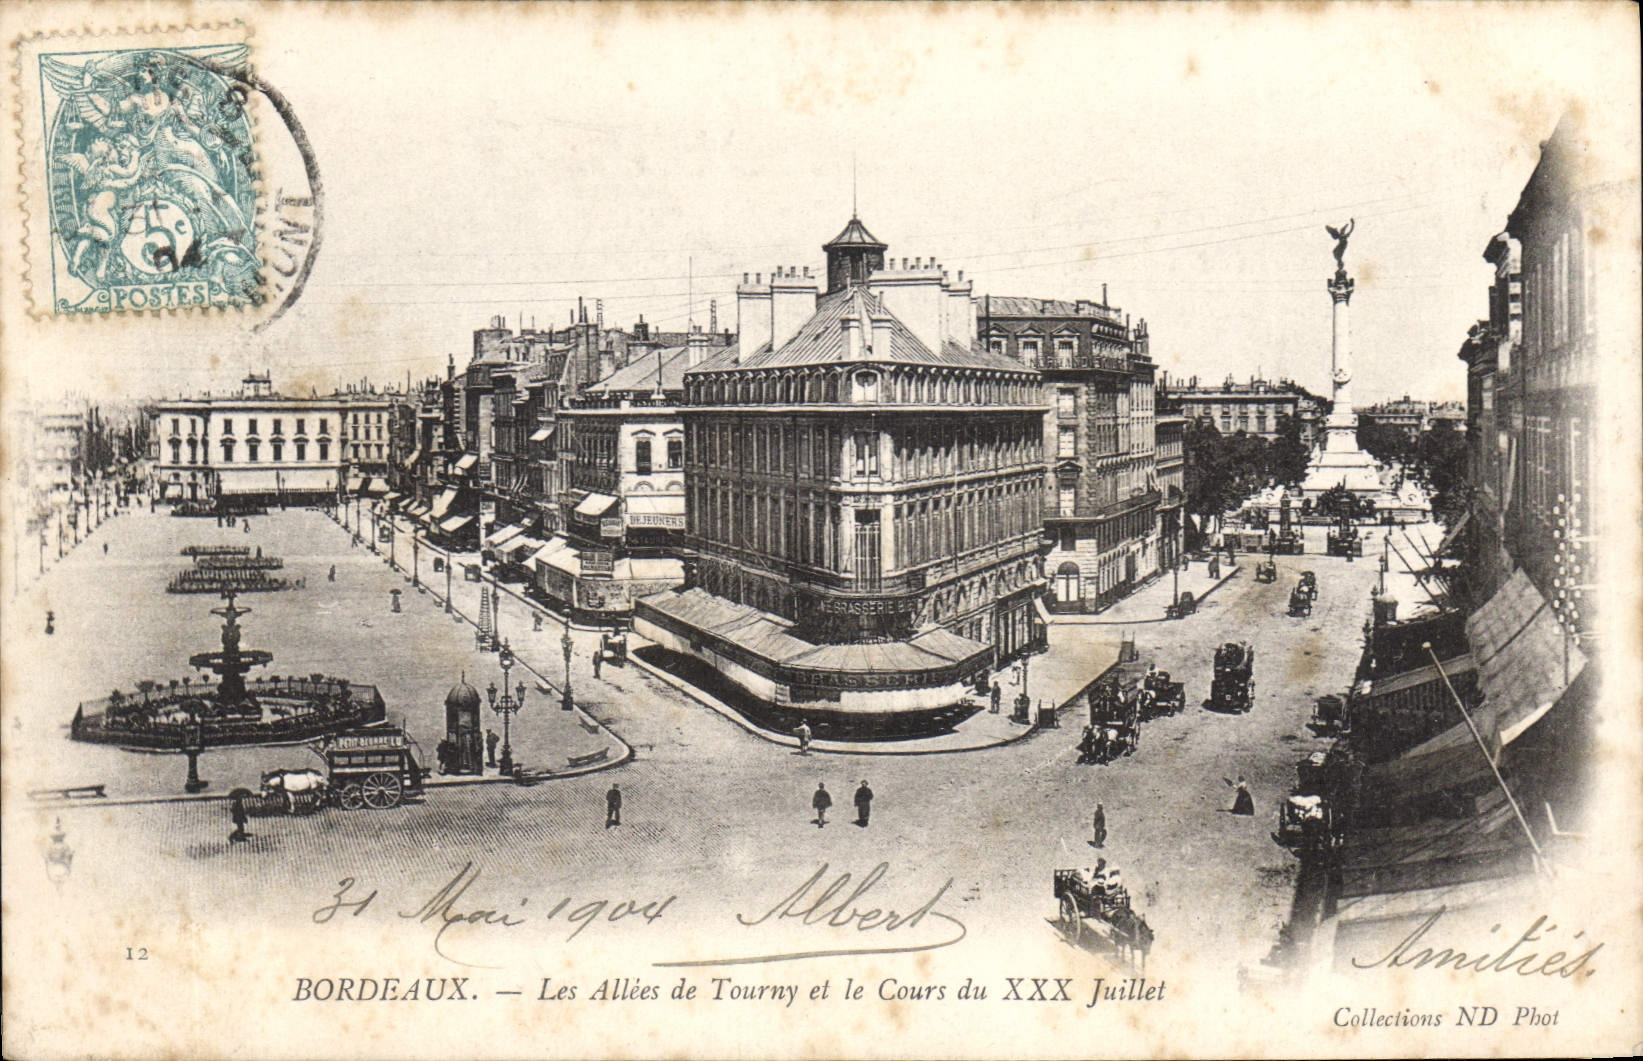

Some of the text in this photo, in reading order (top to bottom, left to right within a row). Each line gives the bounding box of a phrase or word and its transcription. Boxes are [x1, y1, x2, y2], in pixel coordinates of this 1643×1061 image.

[114, 285, 206, 309] POSTES
[629, 514, 685, 527] DEJEUNERS
[338, 736, 358, 749] PETIT
[390, 736, 403, 746] LU
[312, 861, 966, 969] 31 Mai 1904 Albert
